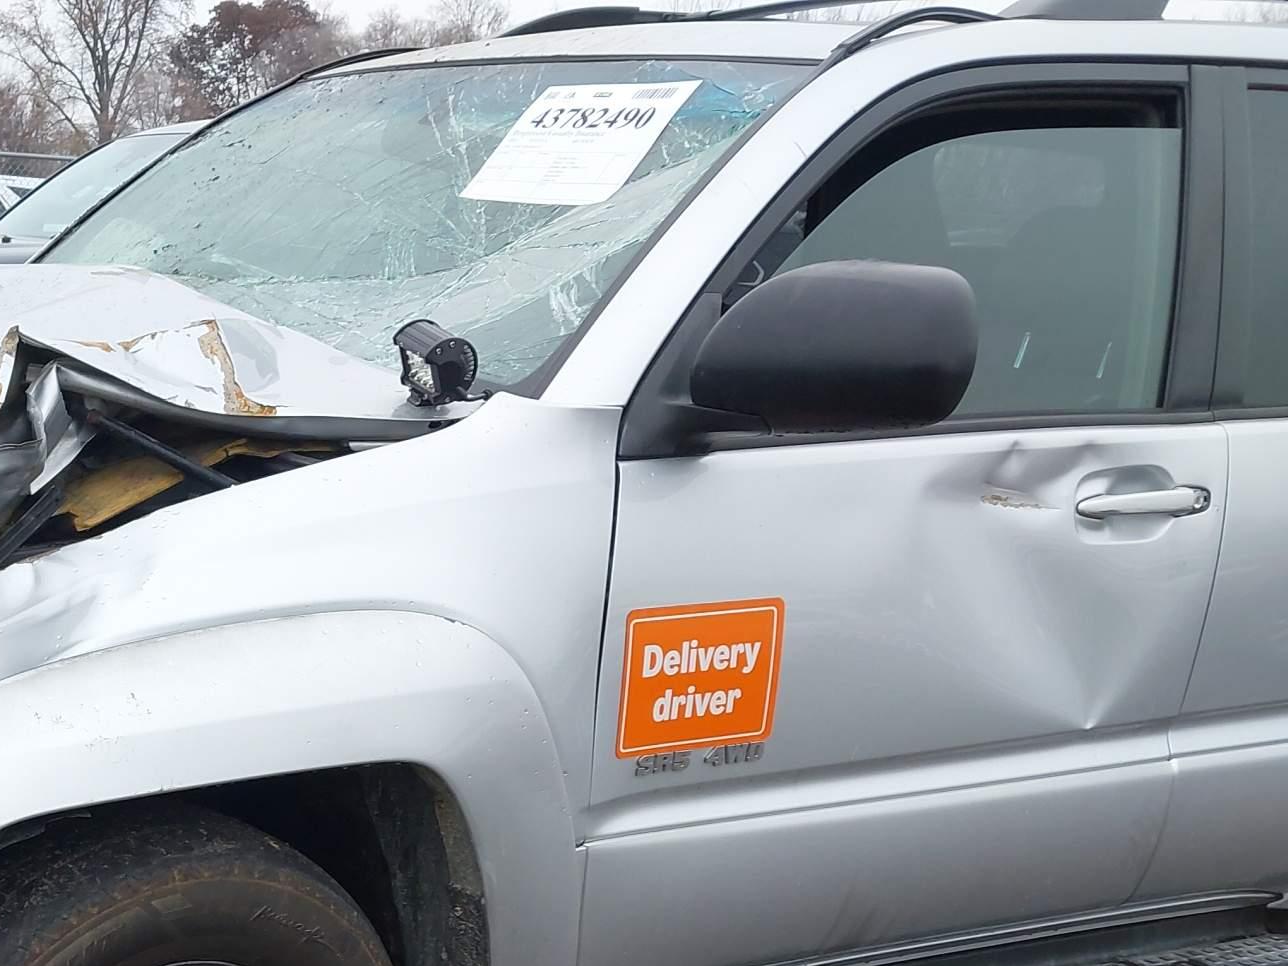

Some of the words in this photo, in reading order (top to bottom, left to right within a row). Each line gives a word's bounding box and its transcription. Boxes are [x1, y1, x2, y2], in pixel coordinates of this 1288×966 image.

[530, 107, 656, 129] 43782490
[642, 639, 762, 679] Delivery
[652, 685, 743, 723] driver
